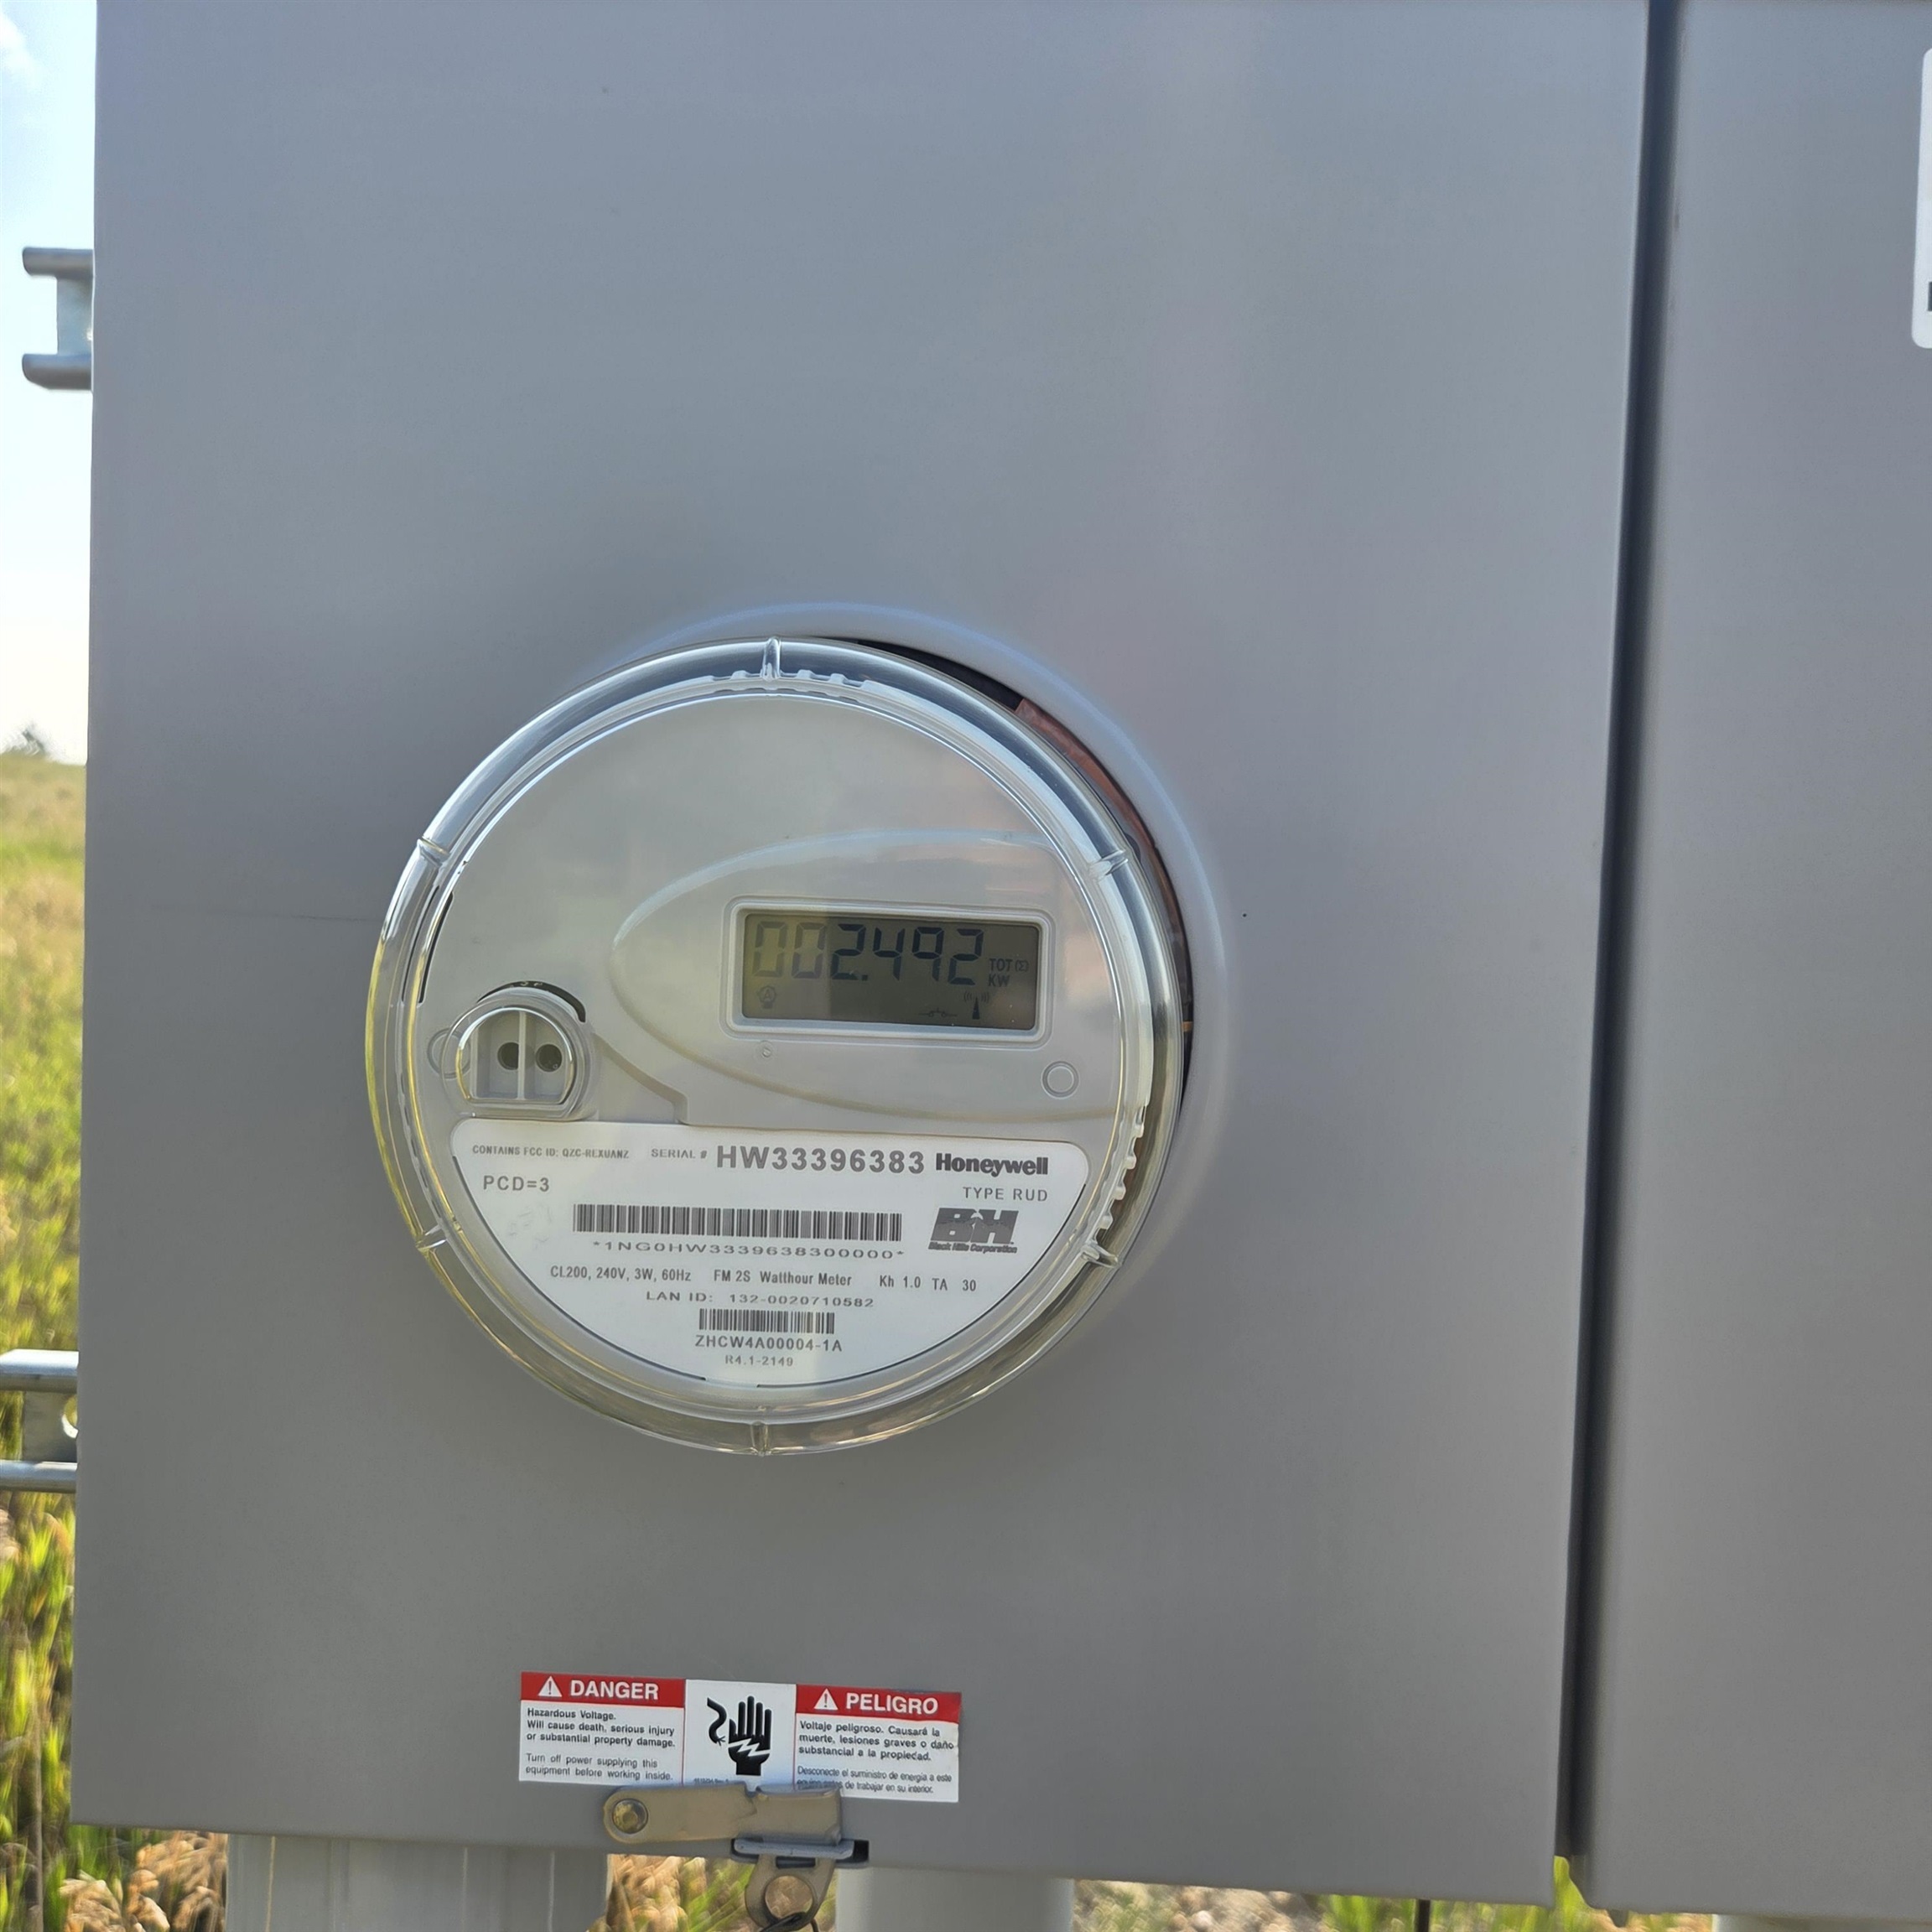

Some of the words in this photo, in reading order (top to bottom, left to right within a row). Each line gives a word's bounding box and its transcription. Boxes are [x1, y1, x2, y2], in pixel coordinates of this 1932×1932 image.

[989, 958, 1013, 972] TOT
[988, 974, 1010, 987] KW
[472, 1145, 520, 1156] CONTAINS
[523, 1146, 543, 1156] FCC
[545, 1148, 559, 1157] ID:
[562, 1148, 629, 1159] QZC-REXUANZ
[651, 1148, 696, 1159] SERIAL
[717, 1145, 924, 1174] HW33396383
[935, 1153, 1048, 1177] Honeywell
[482, 1175, 550, 1192] PCD=3
[963, 1187, 1005, 1201] TYPE
[1013, 1188, 1048, 1202] RUD
[550, 1266, 591, 1281] CL200,
[596, 1267, 630, 1281] 240V,
[634, 1268, 657, 1282] 3W,
[662, 1269, 692, 1282] 60Hz
[714, 1270, 731, 1283] FM
[735, 1270, 751, 1283] 2S
[760, 1270, 813, 1285] Watthour
[818, 1273, 852, 1286] Meter
[880, 1275, 895, 1288] Kh
[903, 1276, 921, 1289] 1.0
[932, 1278, 948, 1291] TA
[963, 1280, 977, 1292] 30
[646, 1291, 681, 1301] LAN
[688, 1293, 713, 1302] ID:
[729, 1294, 874, 1307] 132-0020710582
[694, 1335, 842, 1352] ZHCW4A00004-1A
[724, 1355, 794, 1367] R4.1-2149
[570, 1680, 659, 1700] DANGER
[846, 1692, 938, 1715] PELIGRO
[527, 1708, 576, 1719] Hazardous
[580, 1710, 616, 1722] Voltage.
[527, 1720, 544, 1729] Will
[579, 1722, 607, 1732] death,
[610, 1724, 645, 1734] serious
[648, 1725, 674, 1736] injury
[800, 1721, 832, 1732] Voltaje
[836, 1723, 884, 1735] peligroso.
[888, 1725, 927, 1737] Causará
[932, 1728, 940, 1737] la
[540, 1733, 590, 1743] substantial
[595, 1735, 633, 1747] property
[636, 1737, 675, 1748] damage.
[799, 1735, 835, 1745] muerte,
[839, 1736, 880, 1746] lesiones
[884, 1739, 916, 1748] graves
[798, 1746, 854, 1757] substancial
[868, 1748, 875, 1758] la
[526, 1753, 545, 1763] Turn
[550, 1753, 561, 1763] off
[566, 1756, 593, 1766] power
[597, 1757, 637, 1768] supplying
[642, 1758, 657, 1768] this
[526, 1766, 570, 1777] equipment
[575, 1767, 602, 1777] before
[607, 1769, 641, 1781] working
[646, 1770, 673, 1780] inside.
[797, 1765, 839, 1777] Desconecte
[842, 1768, 849, 1777] el
[850, 1769, 886, 1779] suministro
[889, 1771, 898, 1780] de
[937, 1774, 952, 1782] este
[844, 1779, 854, 1789] de
[856, 1781, 883, 1792] trabajar
[907, 1784, 933, 1794] interior.
